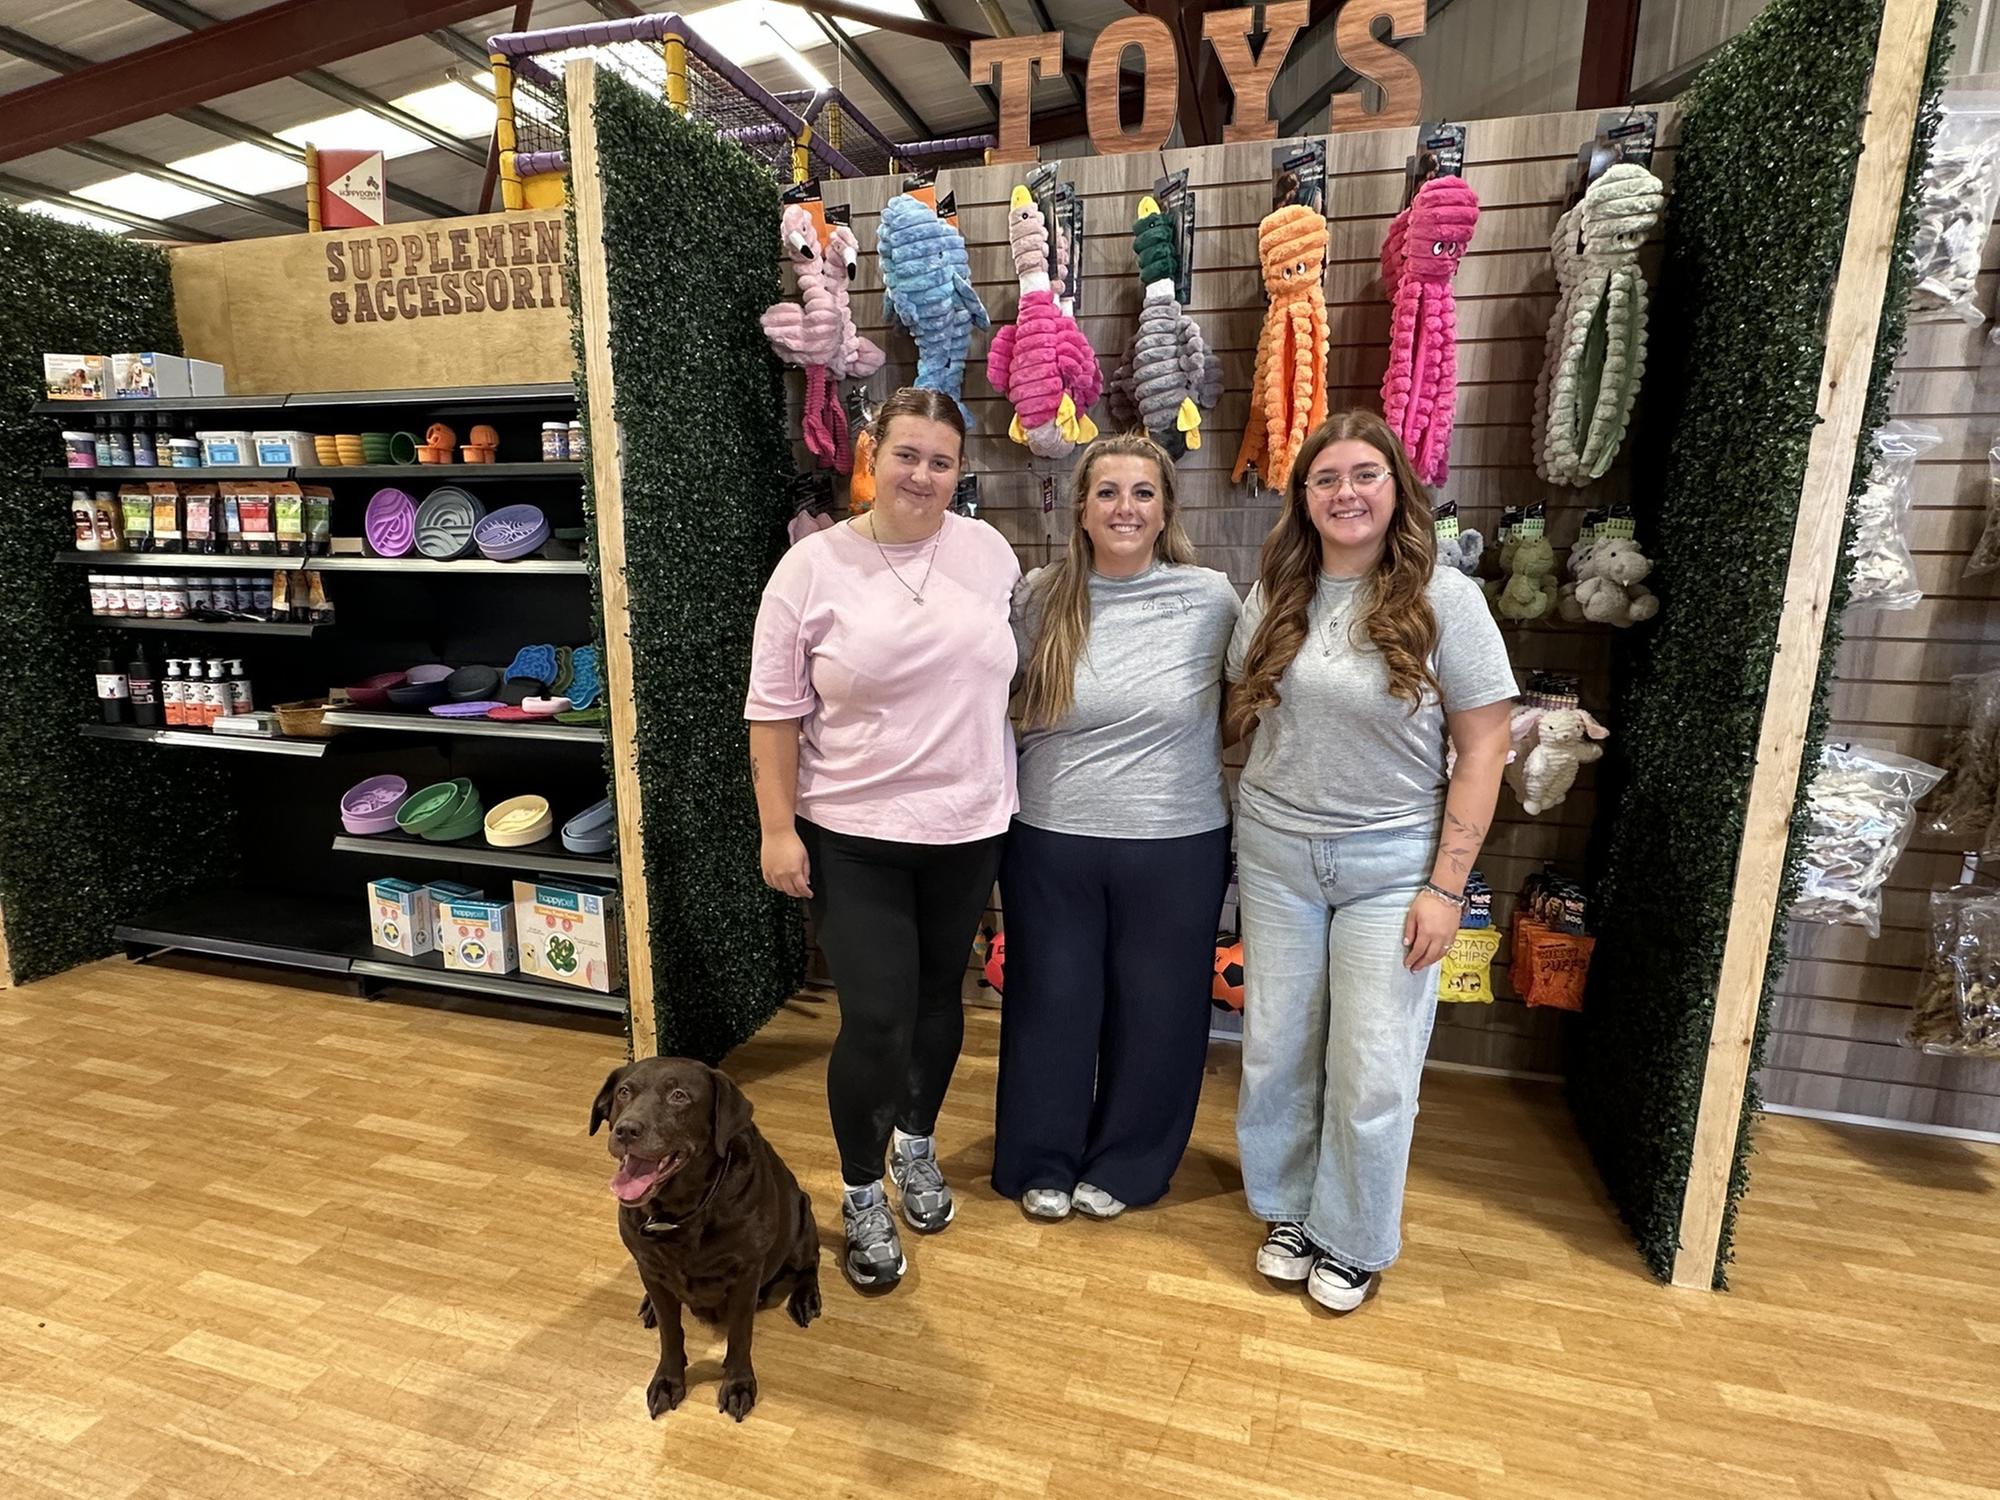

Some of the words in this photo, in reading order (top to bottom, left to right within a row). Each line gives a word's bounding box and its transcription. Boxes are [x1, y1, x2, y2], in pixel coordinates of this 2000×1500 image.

[970, 0, 1427, 166] TOYS
[1452, 939, 1496, 951] OTATO
[1447, 949, 1489, 963] CHIPS
